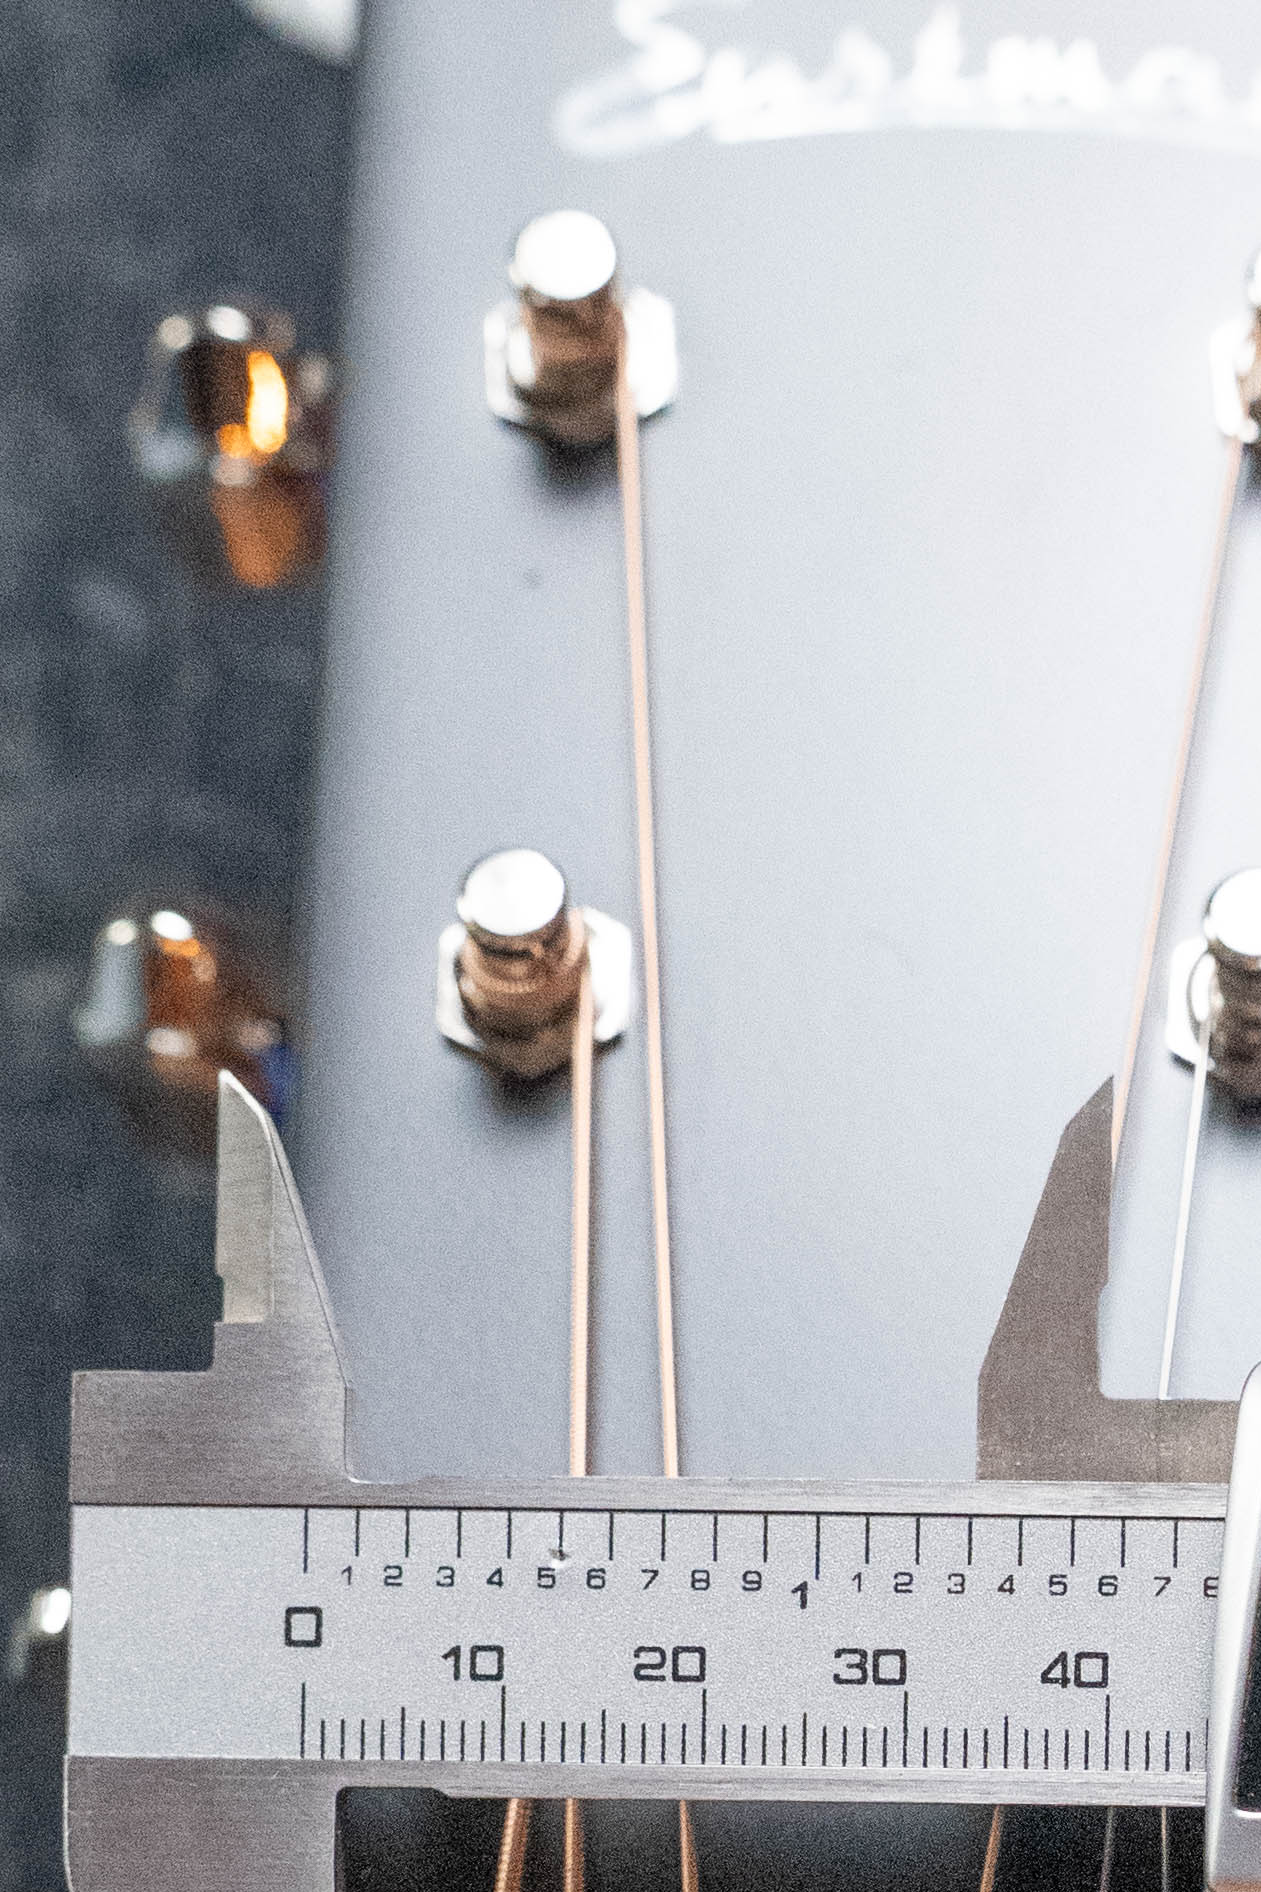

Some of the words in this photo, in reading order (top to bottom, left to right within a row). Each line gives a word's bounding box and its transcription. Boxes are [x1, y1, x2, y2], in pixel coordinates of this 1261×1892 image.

[341, 1567, 353, 1585] 1
[383, 1566, 403, 1587] 2
[436, 1567, 455, 1587] 3
[487, 1568, 504, 1587] 4
[537, 1568, 556, 1589] 5
[586, 1569, 606, 1589] 6
[641, 1569, 659, 1589] 7
[691, 1569, 710, 1591] 8
[742, 1571, 762, 1591] 9
[792, 1582, 808, 1609] 1
[851, 1574, 863, 1592] 1
[893, 1573, 913, 1594] 2
[947, 1574, 966, 1594] 3
[997, 1576, 1015, 1594] 4
[1049, 1575, 1068, 1596] 5
[1098, 1576, 1118, 1596] 6
[1153, 1577, 1171, 1596] 7
[284, 1606, 323, 1647] 0
[441, 1645, 504, 1682] 10
[634, 1646, 706, 1682] 20
[833, 1648, 907, 1686] 30
[1041, 1651, 1109, 1689] 40
